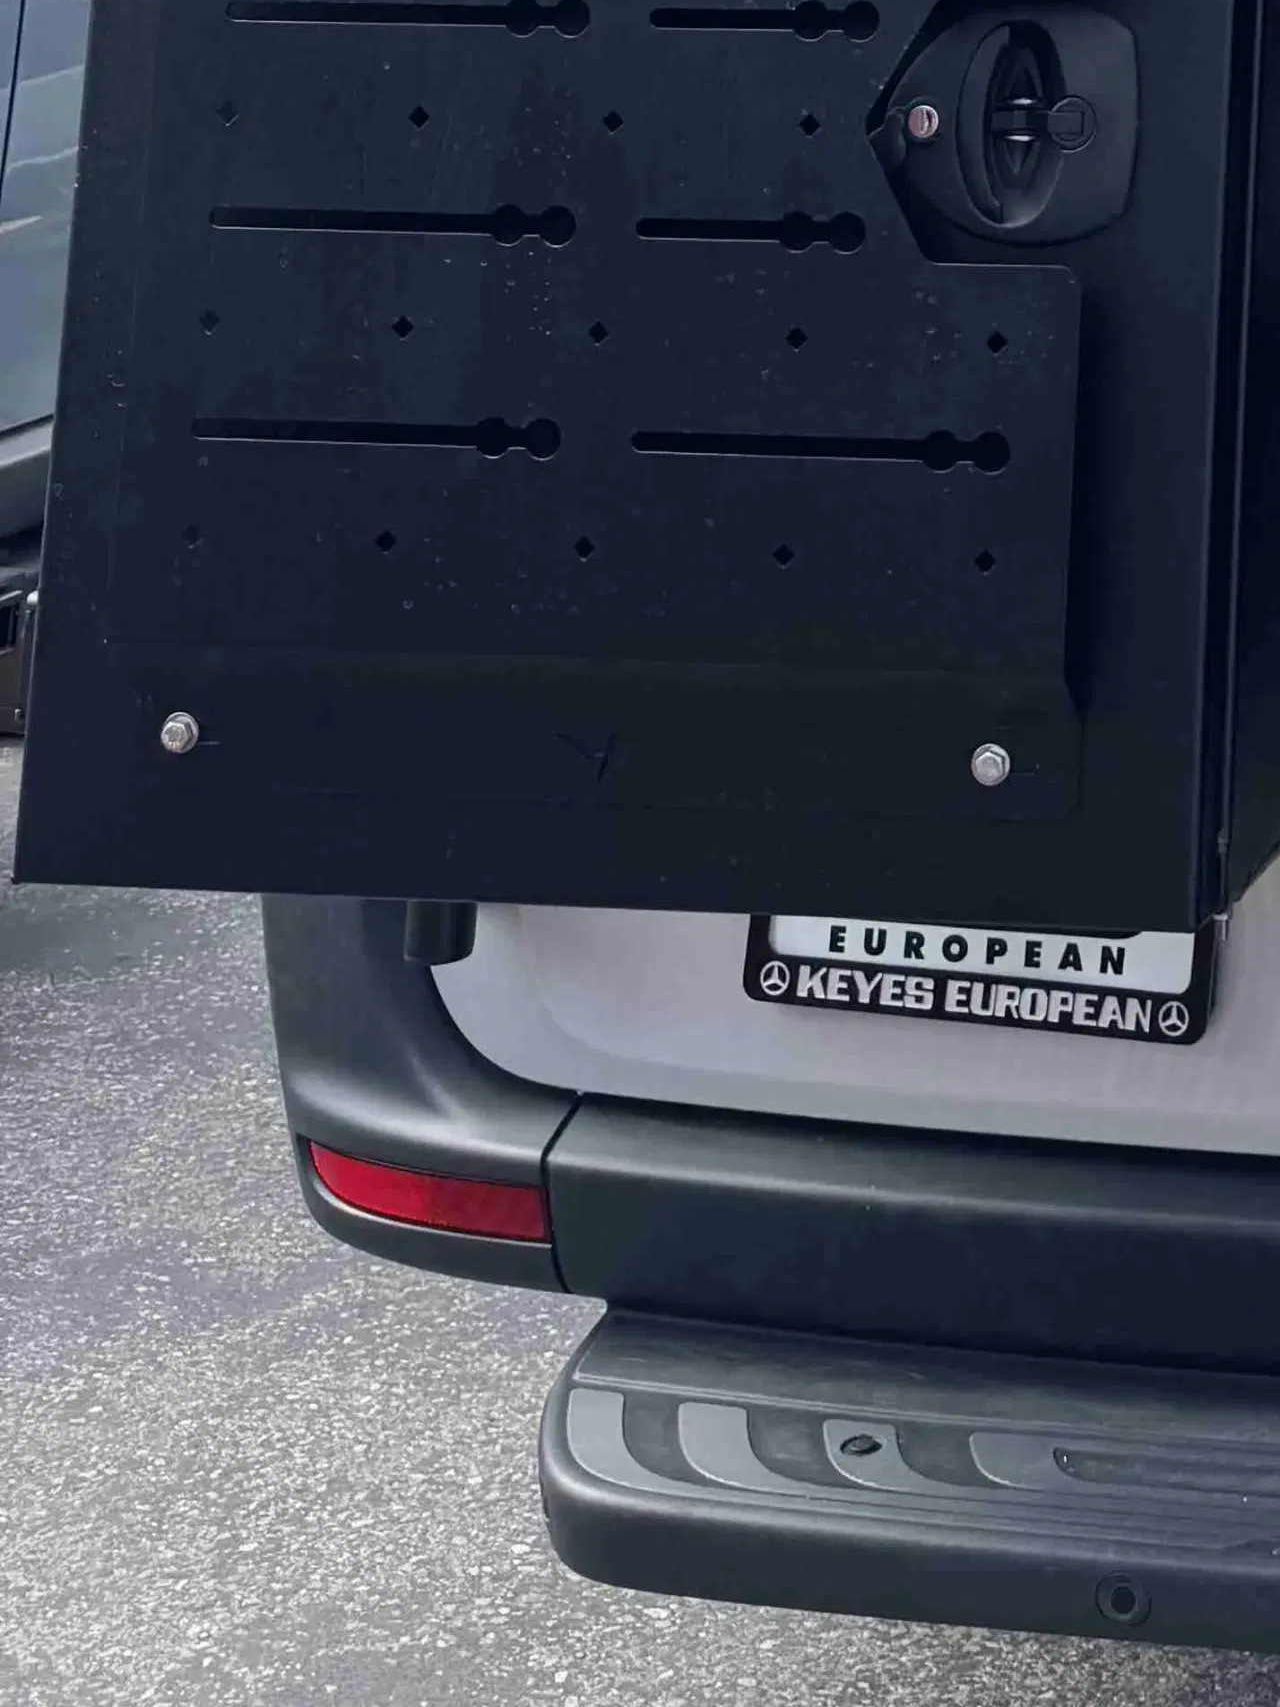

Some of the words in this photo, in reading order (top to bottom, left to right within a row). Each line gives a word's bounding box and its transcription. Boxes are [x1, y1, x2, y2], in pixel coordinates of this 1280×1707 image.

[828, 924, 1126, 976] EUROPEAN
[796, 963, 935, 1011] KEYES
[944, 977, 1153, 1034] EUROPEAN
